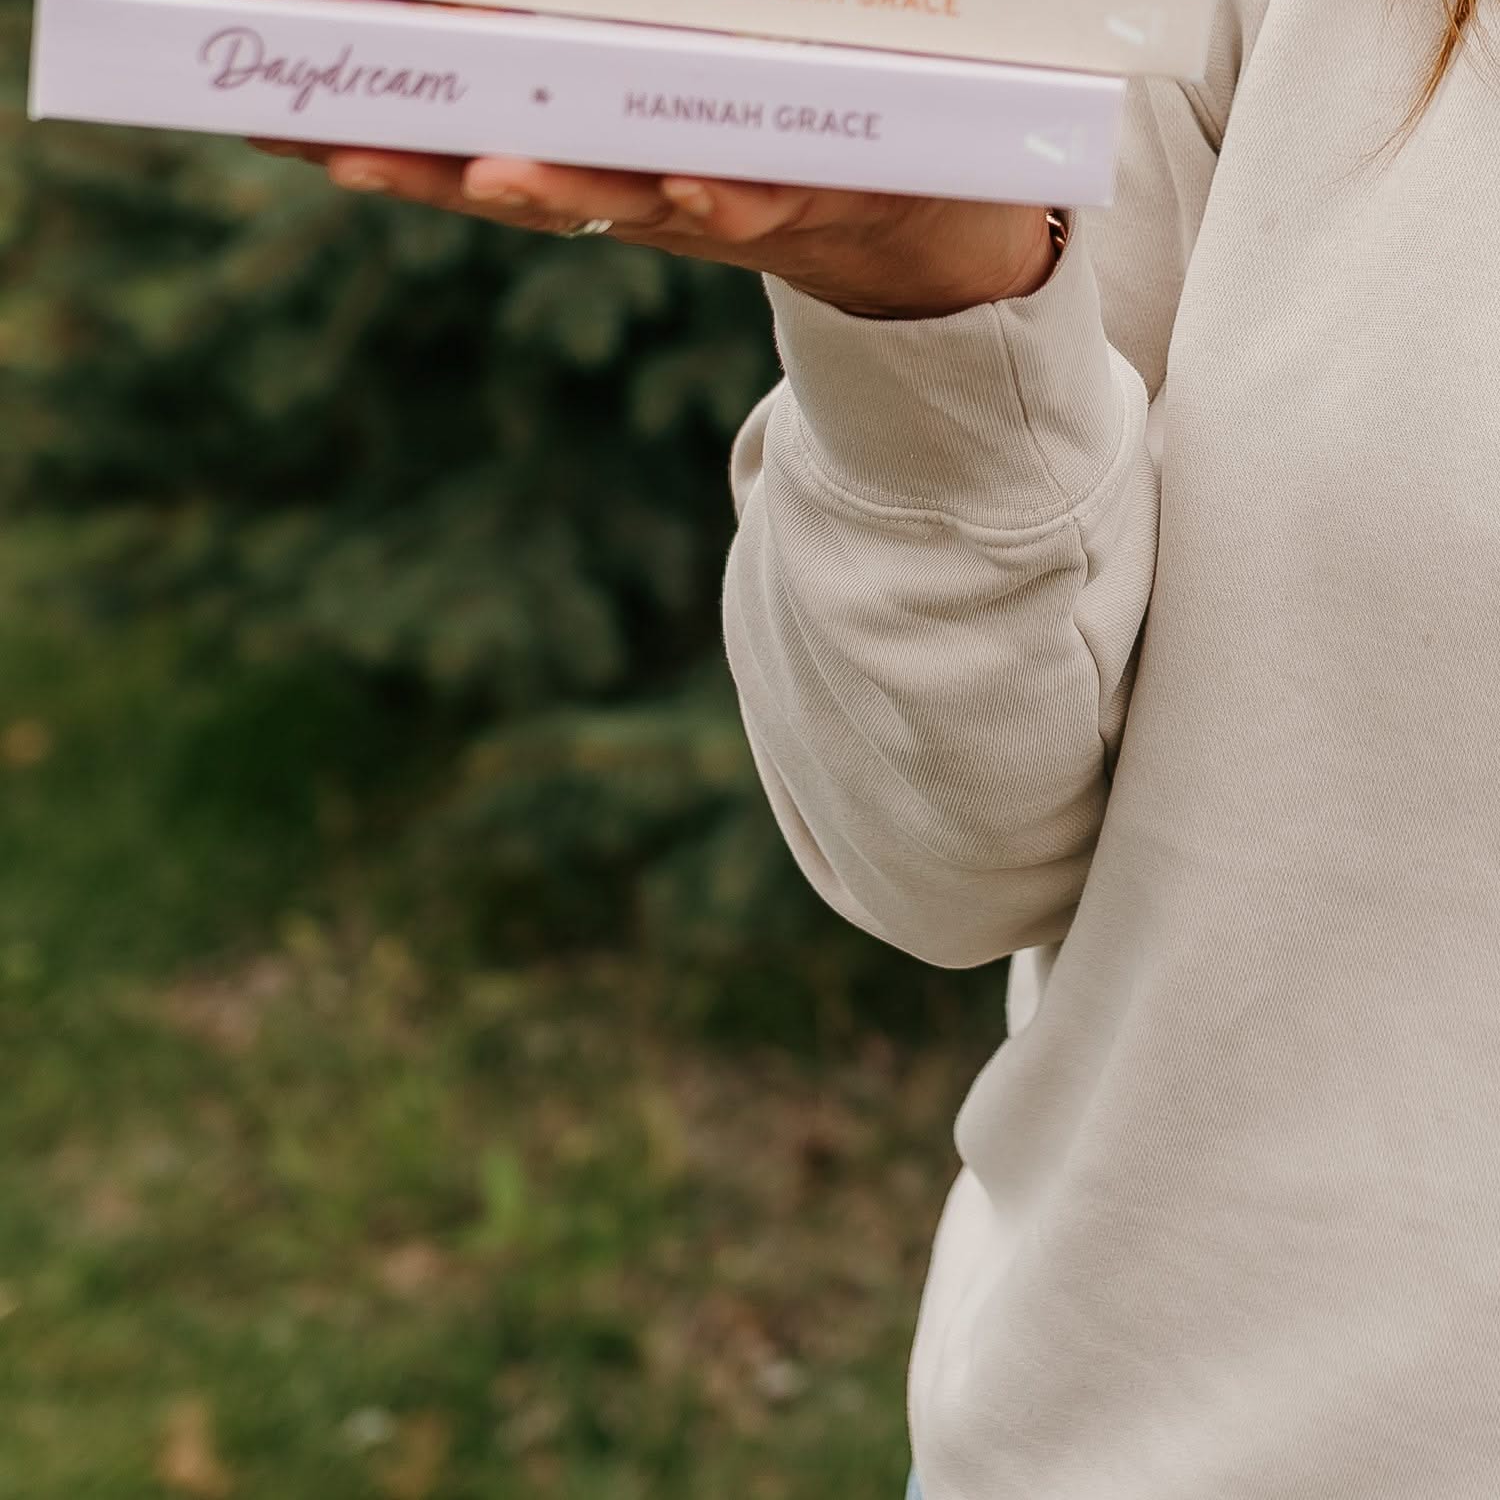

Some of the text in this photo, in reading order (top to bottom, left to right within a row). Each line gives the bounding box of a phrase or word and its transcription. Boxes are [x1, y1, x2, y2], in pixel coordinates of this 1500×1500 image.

[201, 27, 882, 141] Daydream HANNAH GRACE
